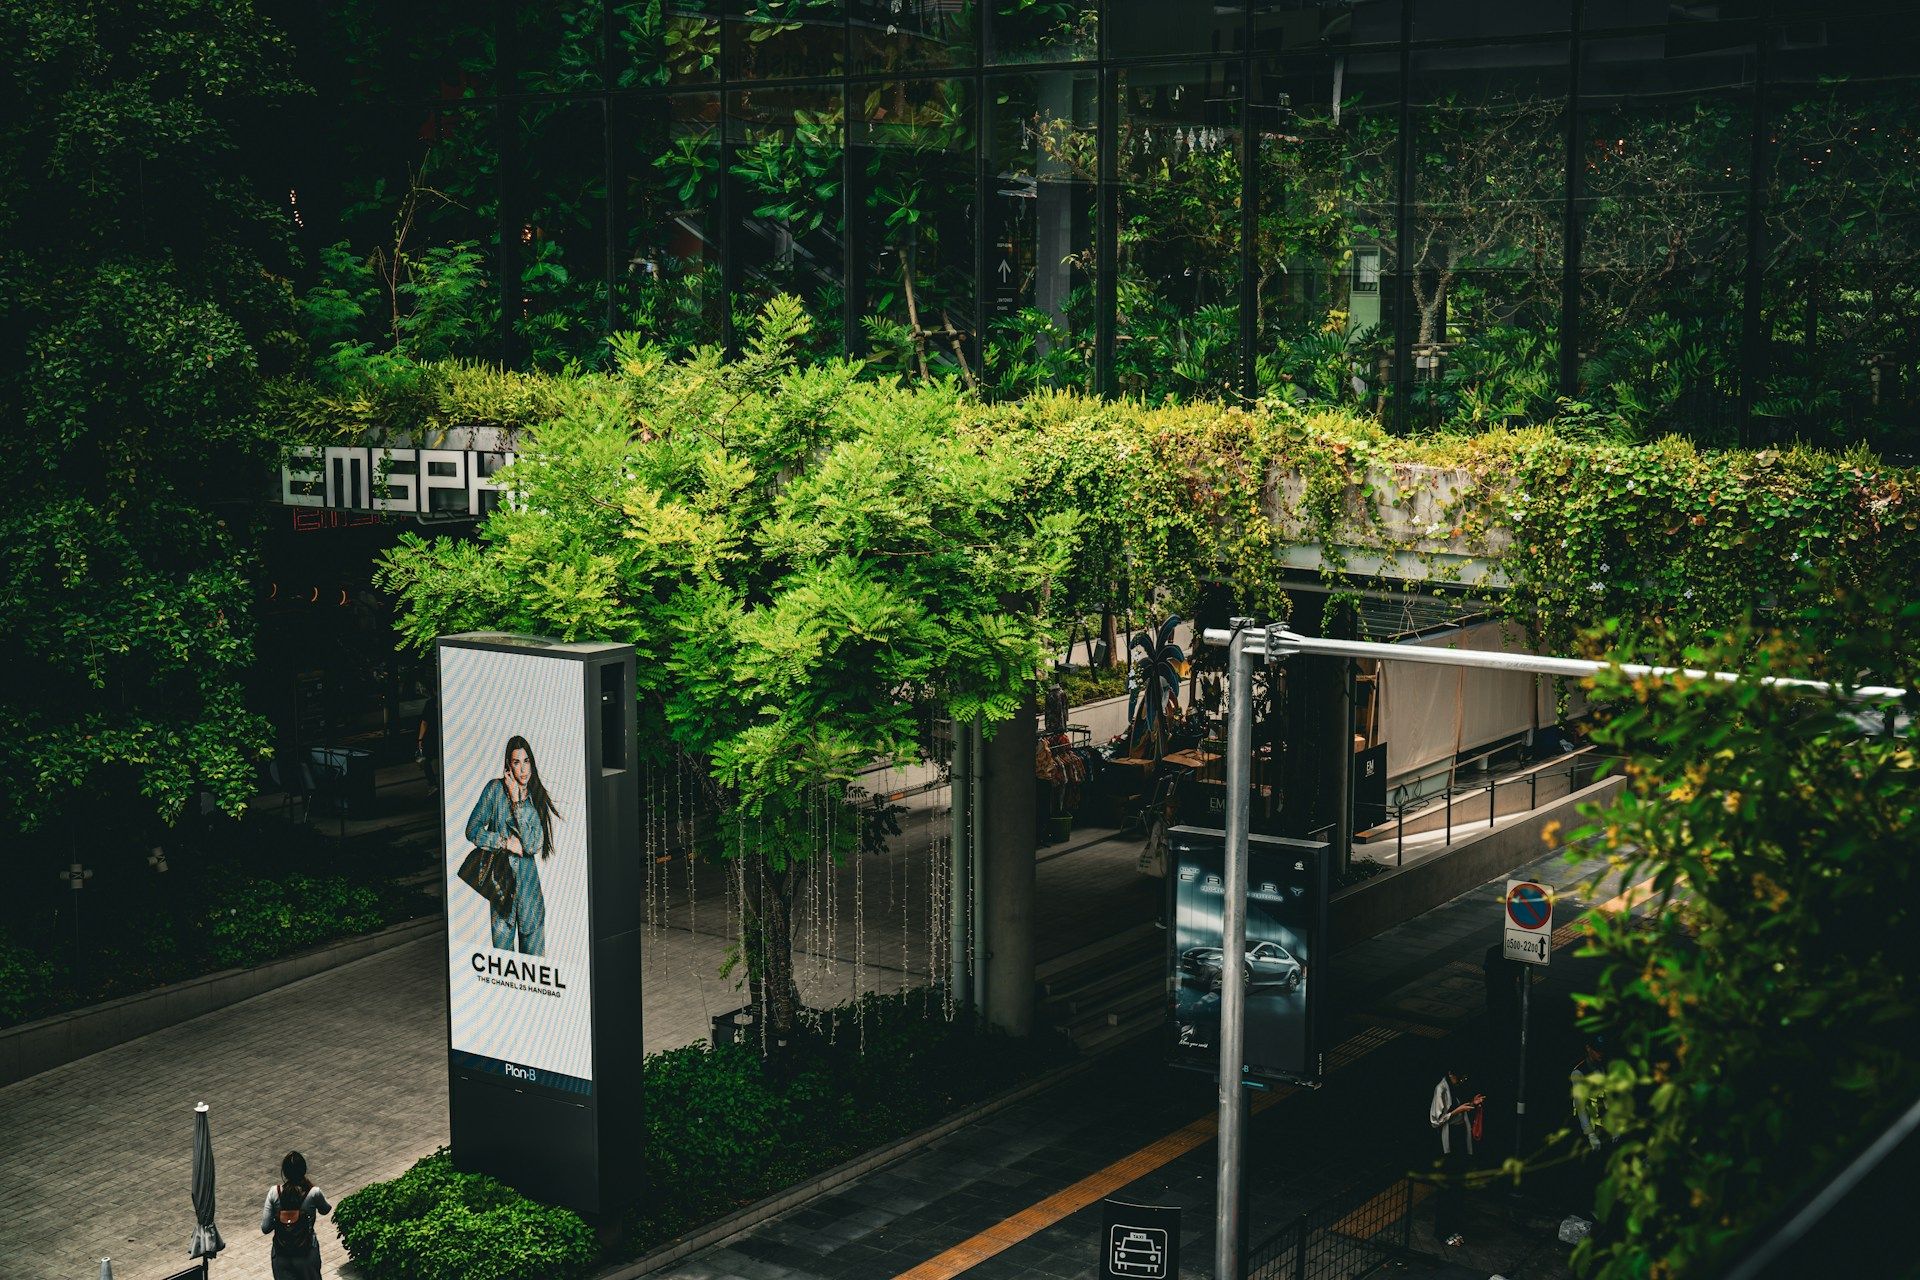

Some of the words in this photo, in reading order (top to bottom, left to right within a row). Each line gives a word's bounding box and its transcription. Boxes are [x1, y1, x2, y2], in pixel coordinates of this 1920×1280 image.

[282, 445, 536, 516] EMSPH
[1180, 873, 1304, 897] CARY
[472, 953, 566, 989] CHANEL
[477, 975, 490, 984] THE
[491, 977, 518, 990] CHANEL
[519, 983, 527, 991] 25
[528, 985, 561, 998] HANDBAG
